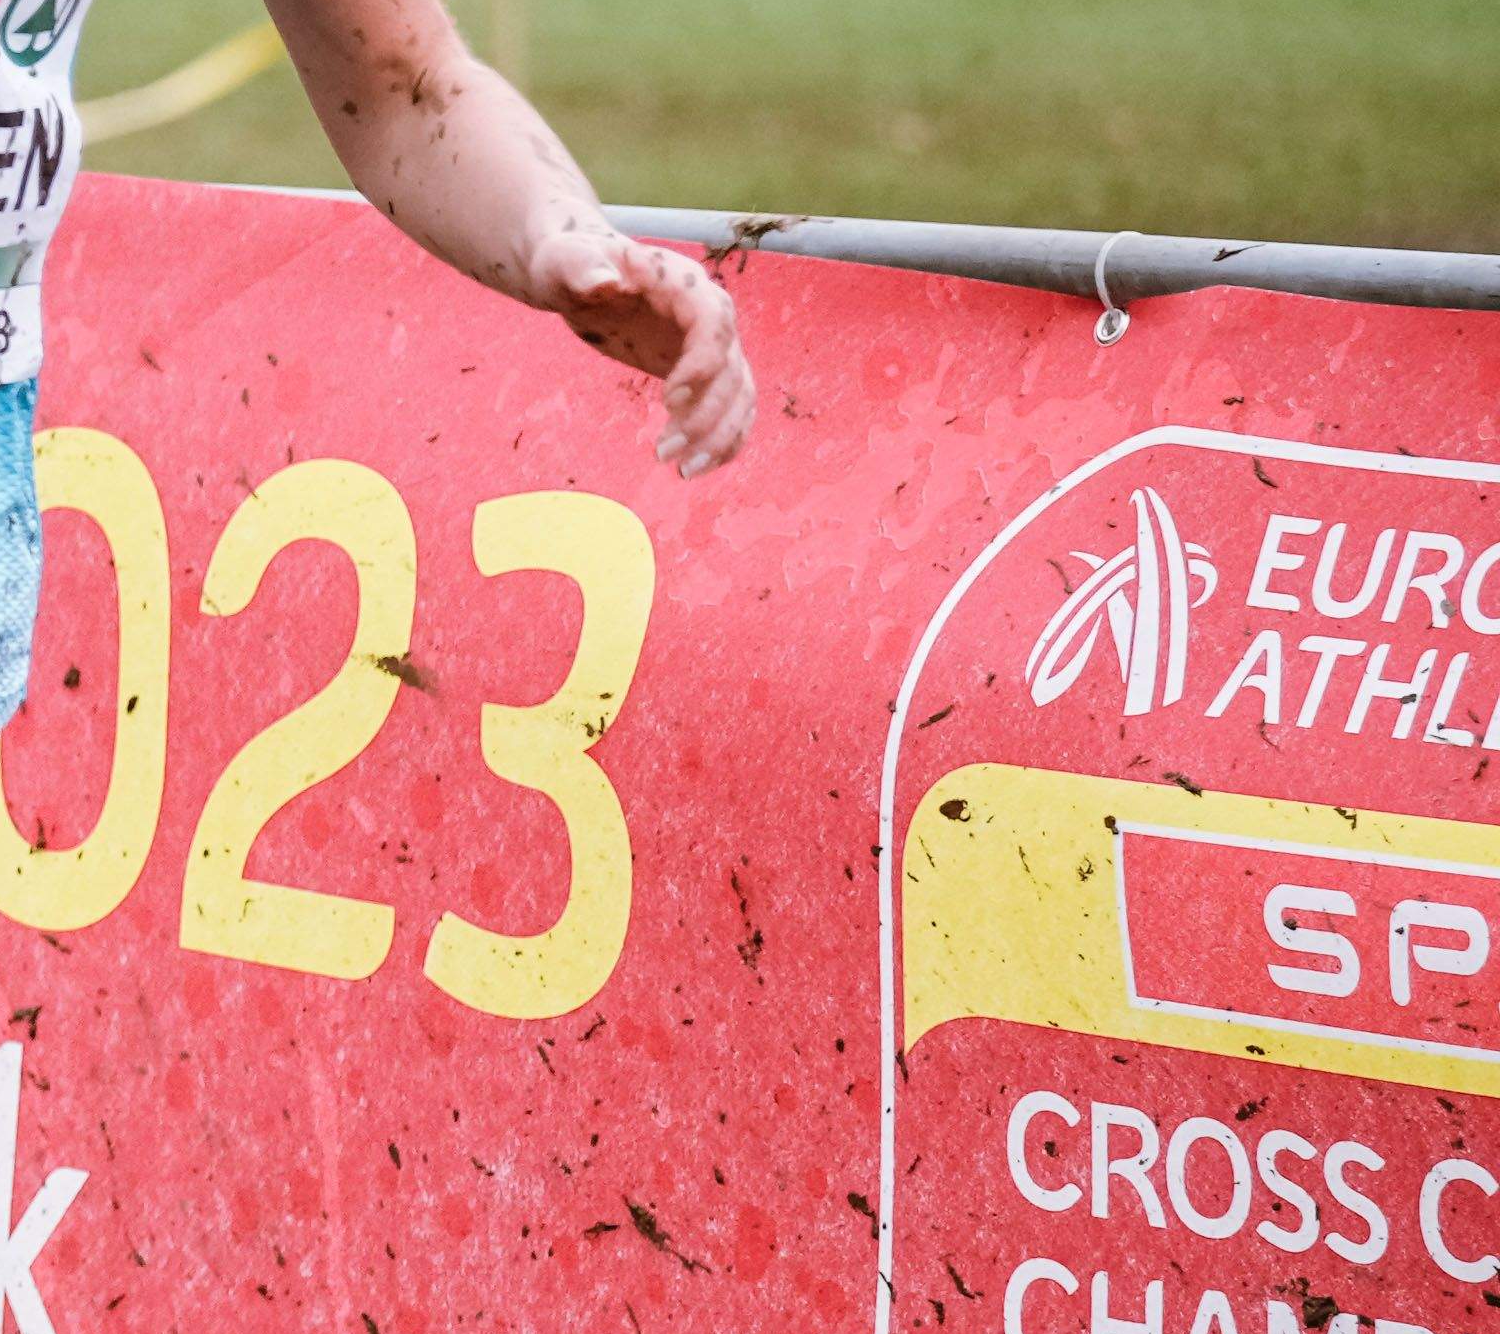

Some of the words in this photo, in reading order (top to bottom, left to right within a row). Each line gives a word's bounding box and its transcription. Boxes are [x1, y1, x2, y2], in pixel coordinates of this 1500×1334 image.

[1203, 629, 1500, 751] ATHL
[1263, 883, 1490, 1007] SP
[1006, 1090, 1389, 1266] CROSS
